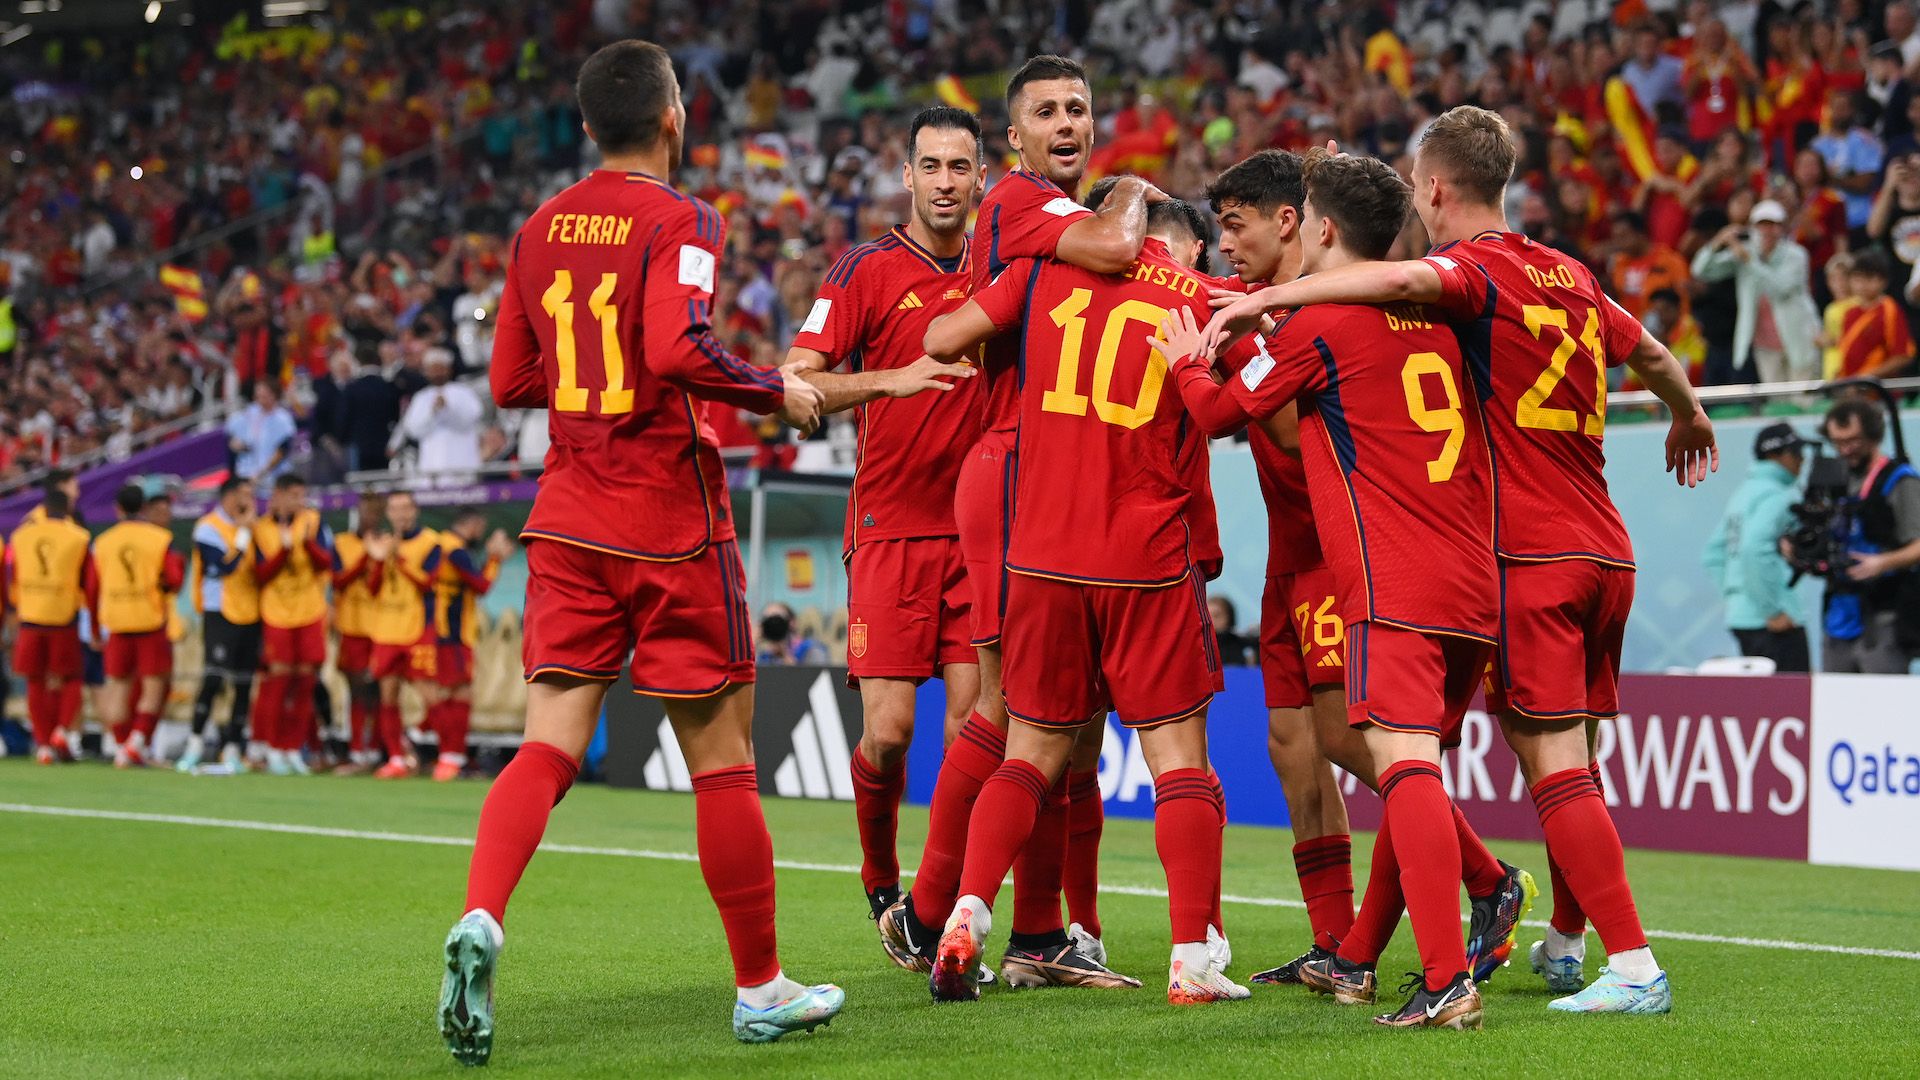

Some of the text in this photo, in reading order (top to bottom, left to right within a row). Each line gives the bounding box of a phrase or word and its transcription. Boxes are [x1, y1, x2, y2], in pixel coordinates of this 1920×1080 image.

[546, 213, 633, 245] FERRAN
[540, 269, 635, 414] 11
[1041, 287, 1170, 430] 10
[1515, 304, 1605, 436] 21
[1401, 351, 1466, 484] 9
[1294, 595, 1344, 657] 26
[1509, 712, 1807, 817] RWAYS
[1828, 741, 1920, 804] Qata
